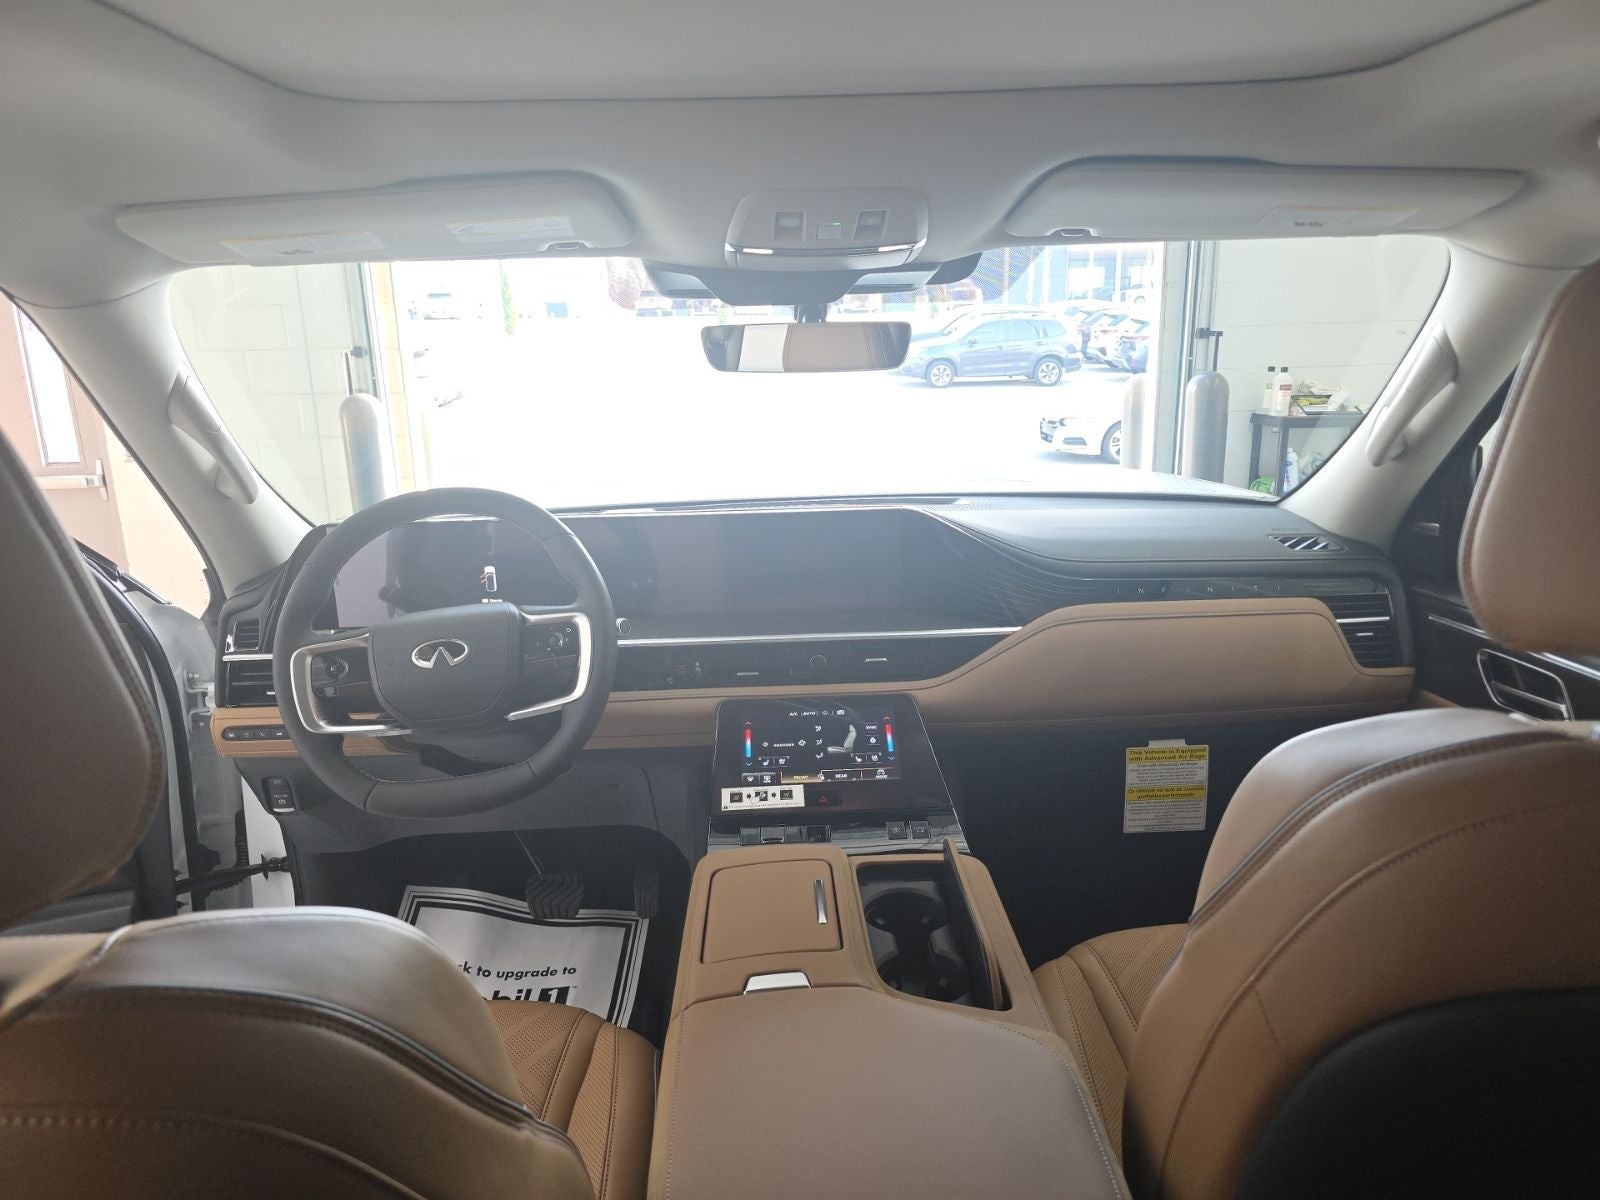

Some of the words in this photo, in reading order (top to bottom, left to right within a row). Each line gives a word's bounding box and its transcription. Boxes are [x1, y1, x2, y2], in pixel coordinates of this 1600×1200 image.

[1117, 585, 1280, 595] INFINITI
[476, 966, 491, 977] to
[496, 966, 558, 981] upgrade
[562, 966, 577, 975] to
